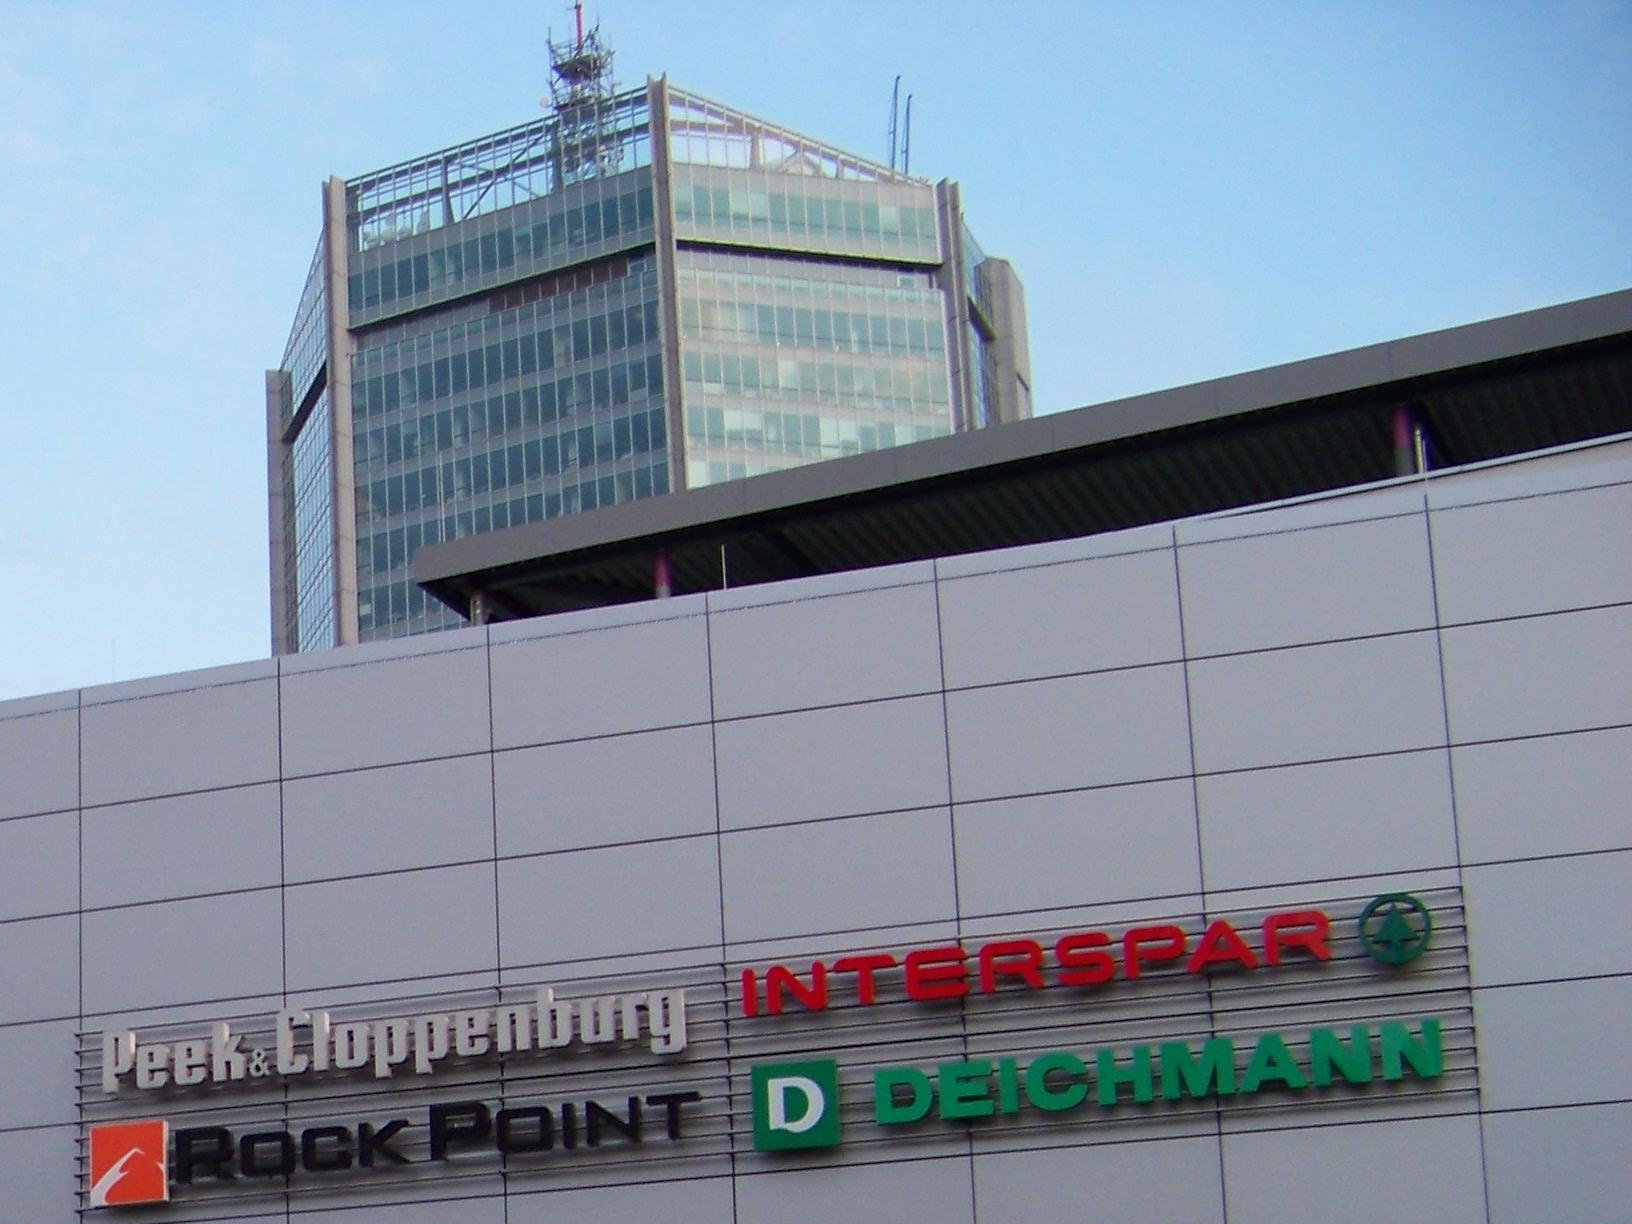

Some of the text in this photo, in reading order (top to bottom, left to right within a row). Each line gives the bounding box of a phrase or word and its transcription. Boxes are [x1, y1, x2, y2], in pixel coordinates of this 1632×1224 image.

[741, 910, 1332, 1017] INTERSPAR
[768, 1018, 1446, 1132] D DEICHMANN
